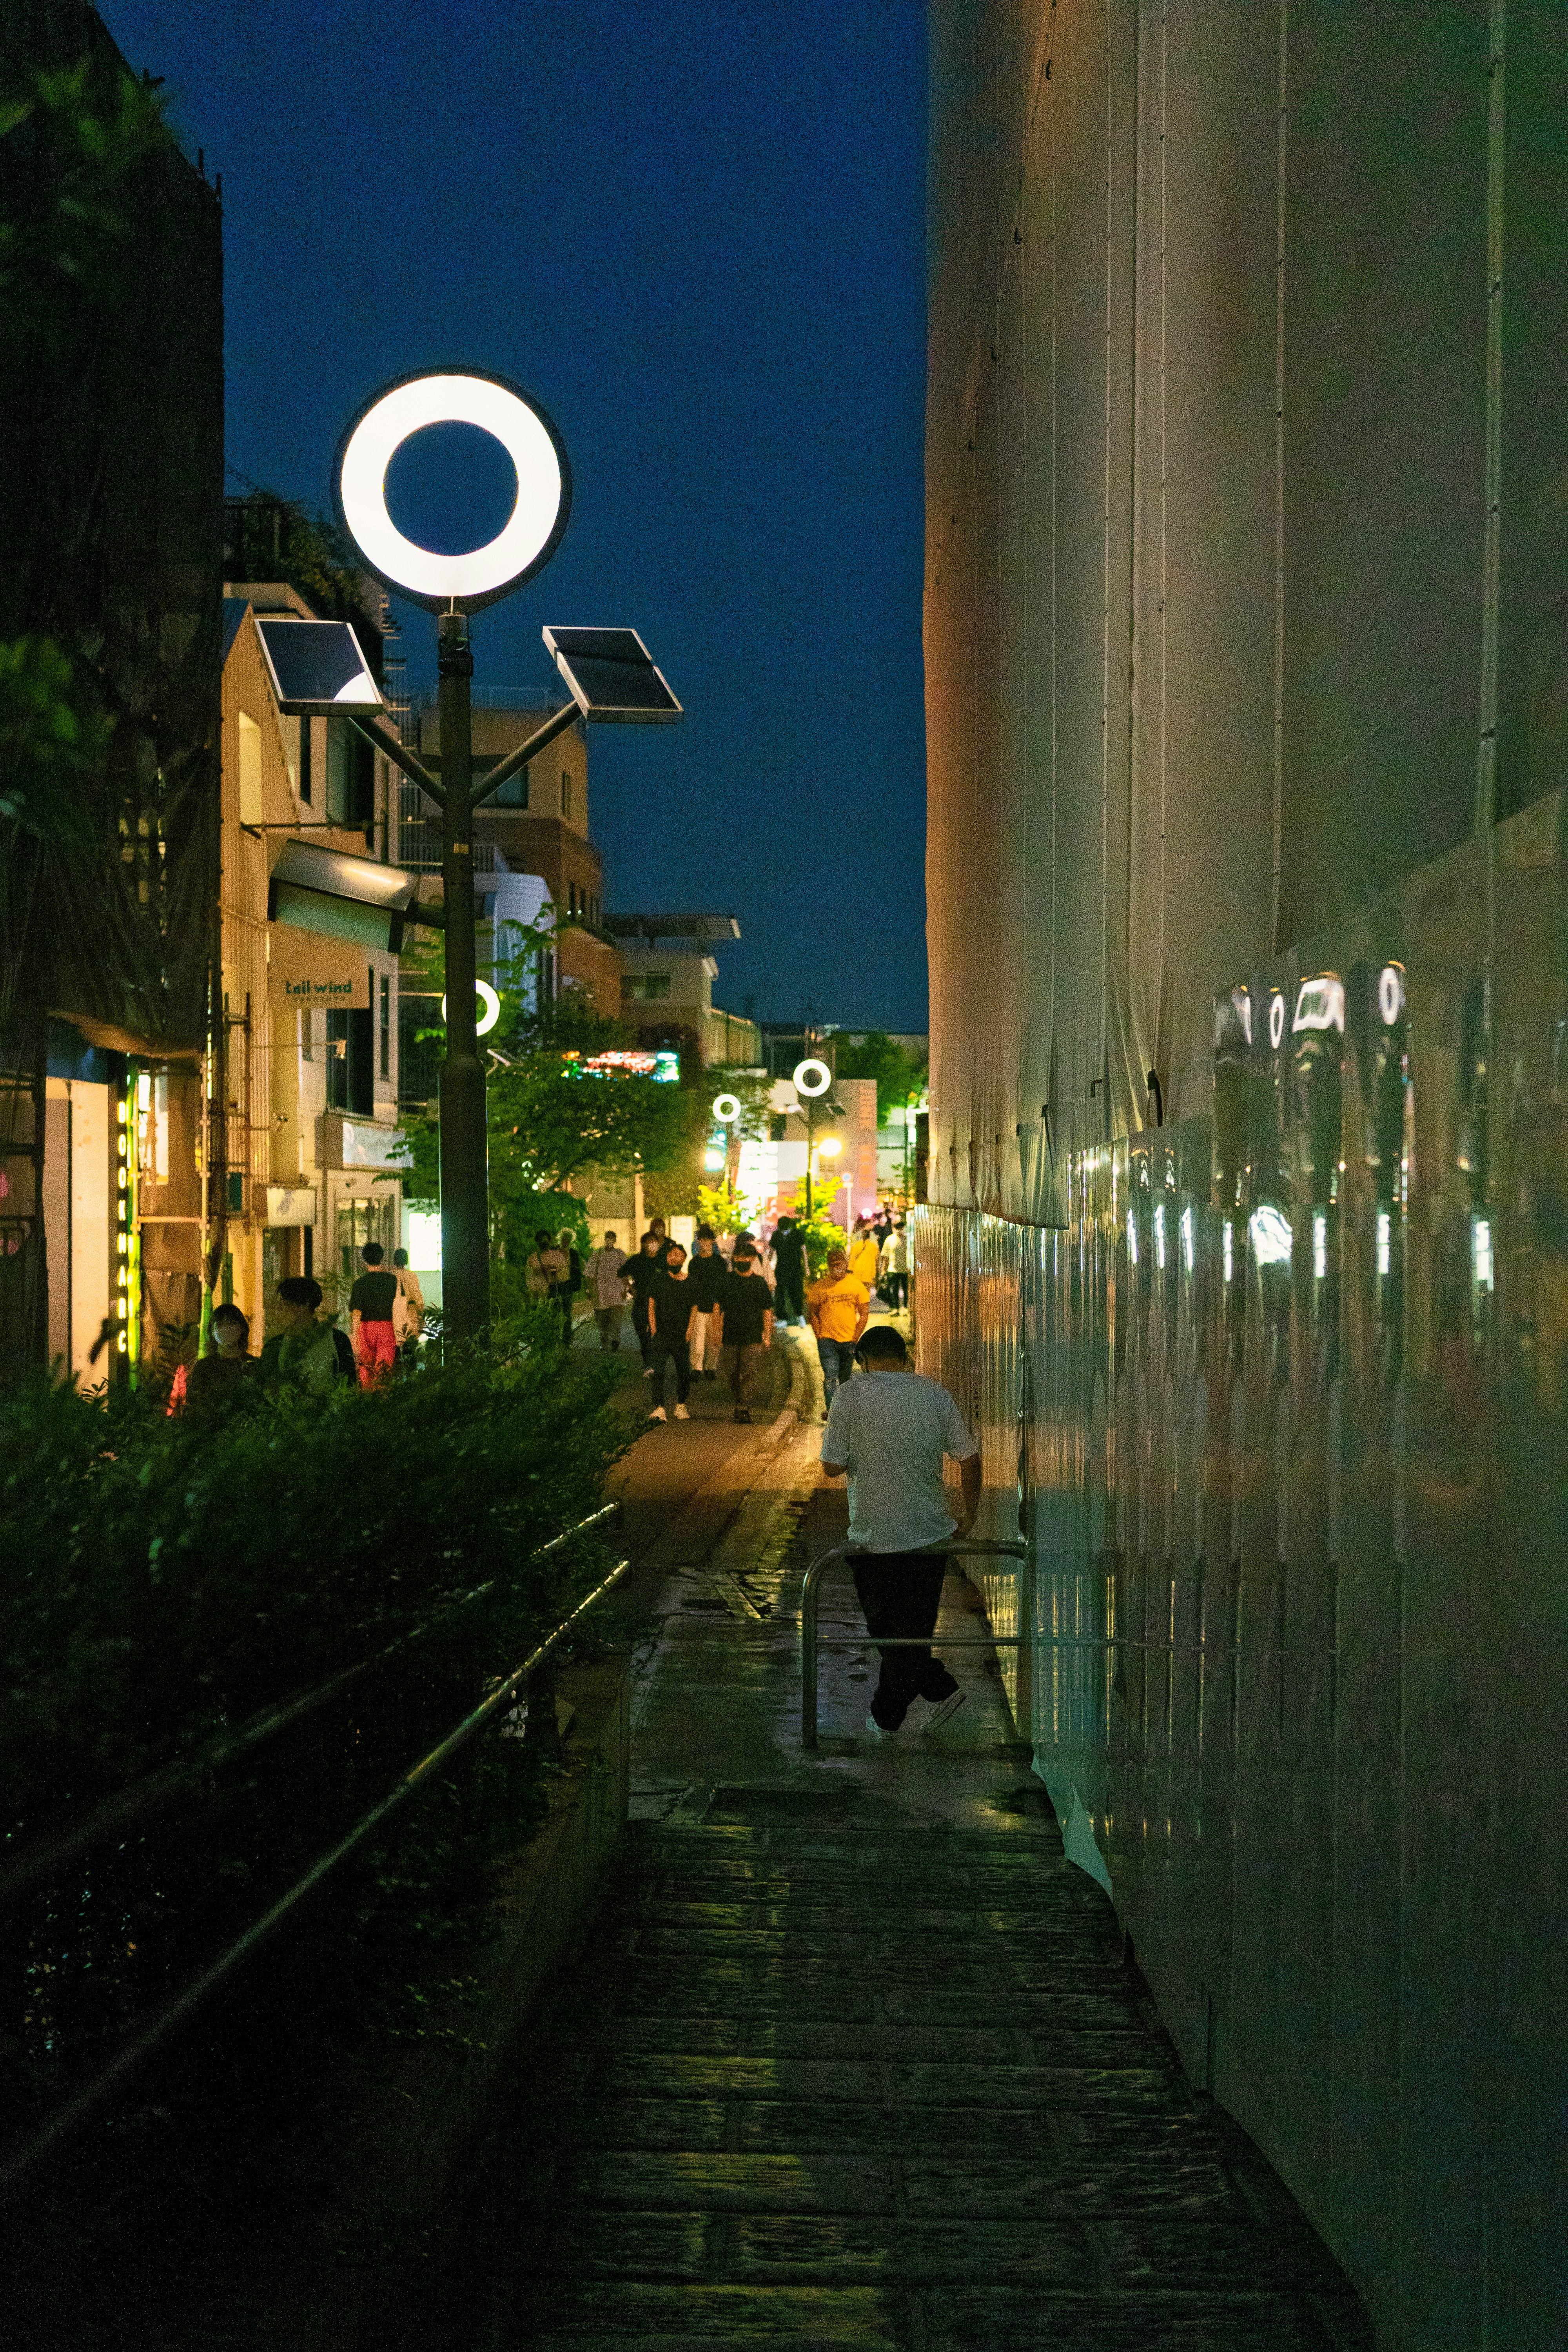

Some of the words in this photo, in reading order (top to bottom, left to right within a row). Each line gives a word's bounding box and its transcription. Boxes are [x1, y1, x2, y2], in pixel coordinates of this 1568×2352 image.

[286, 980, 310, 994] tail
[314, 979, 352, 993] wind
[118, 1101, 126, 1353] BOOKMARC
